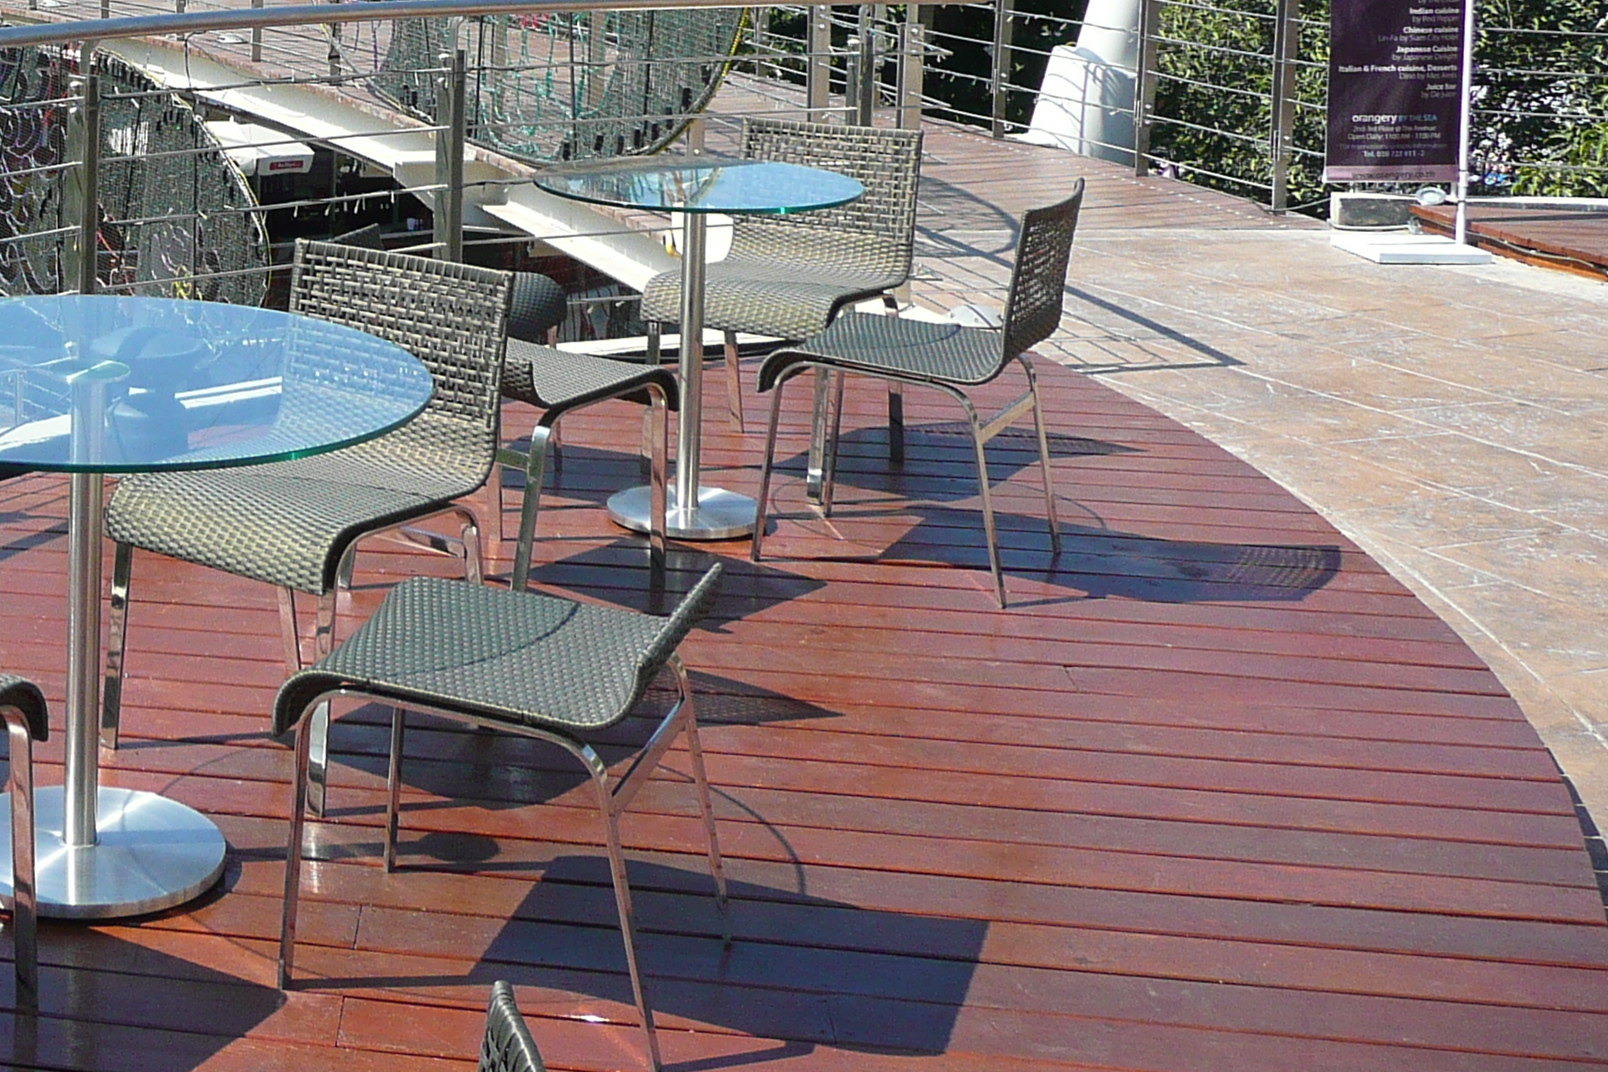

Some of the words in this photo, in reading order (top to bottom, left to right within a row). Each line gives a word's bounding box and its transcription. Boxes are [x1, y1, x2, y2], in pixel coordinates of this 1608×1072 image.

[1403, 26, 1433, 34] Chinese
[1395, 45, 1431, 54] Japanese
[1432, 44, 1458, 52] Cuisine
[1338, 65, 1362, 73] Italian
[1370, 64, 1396, 72] French
[1427, 63, 1458, 71] Desserts
[1352, 114, 1398, 124] orangery
